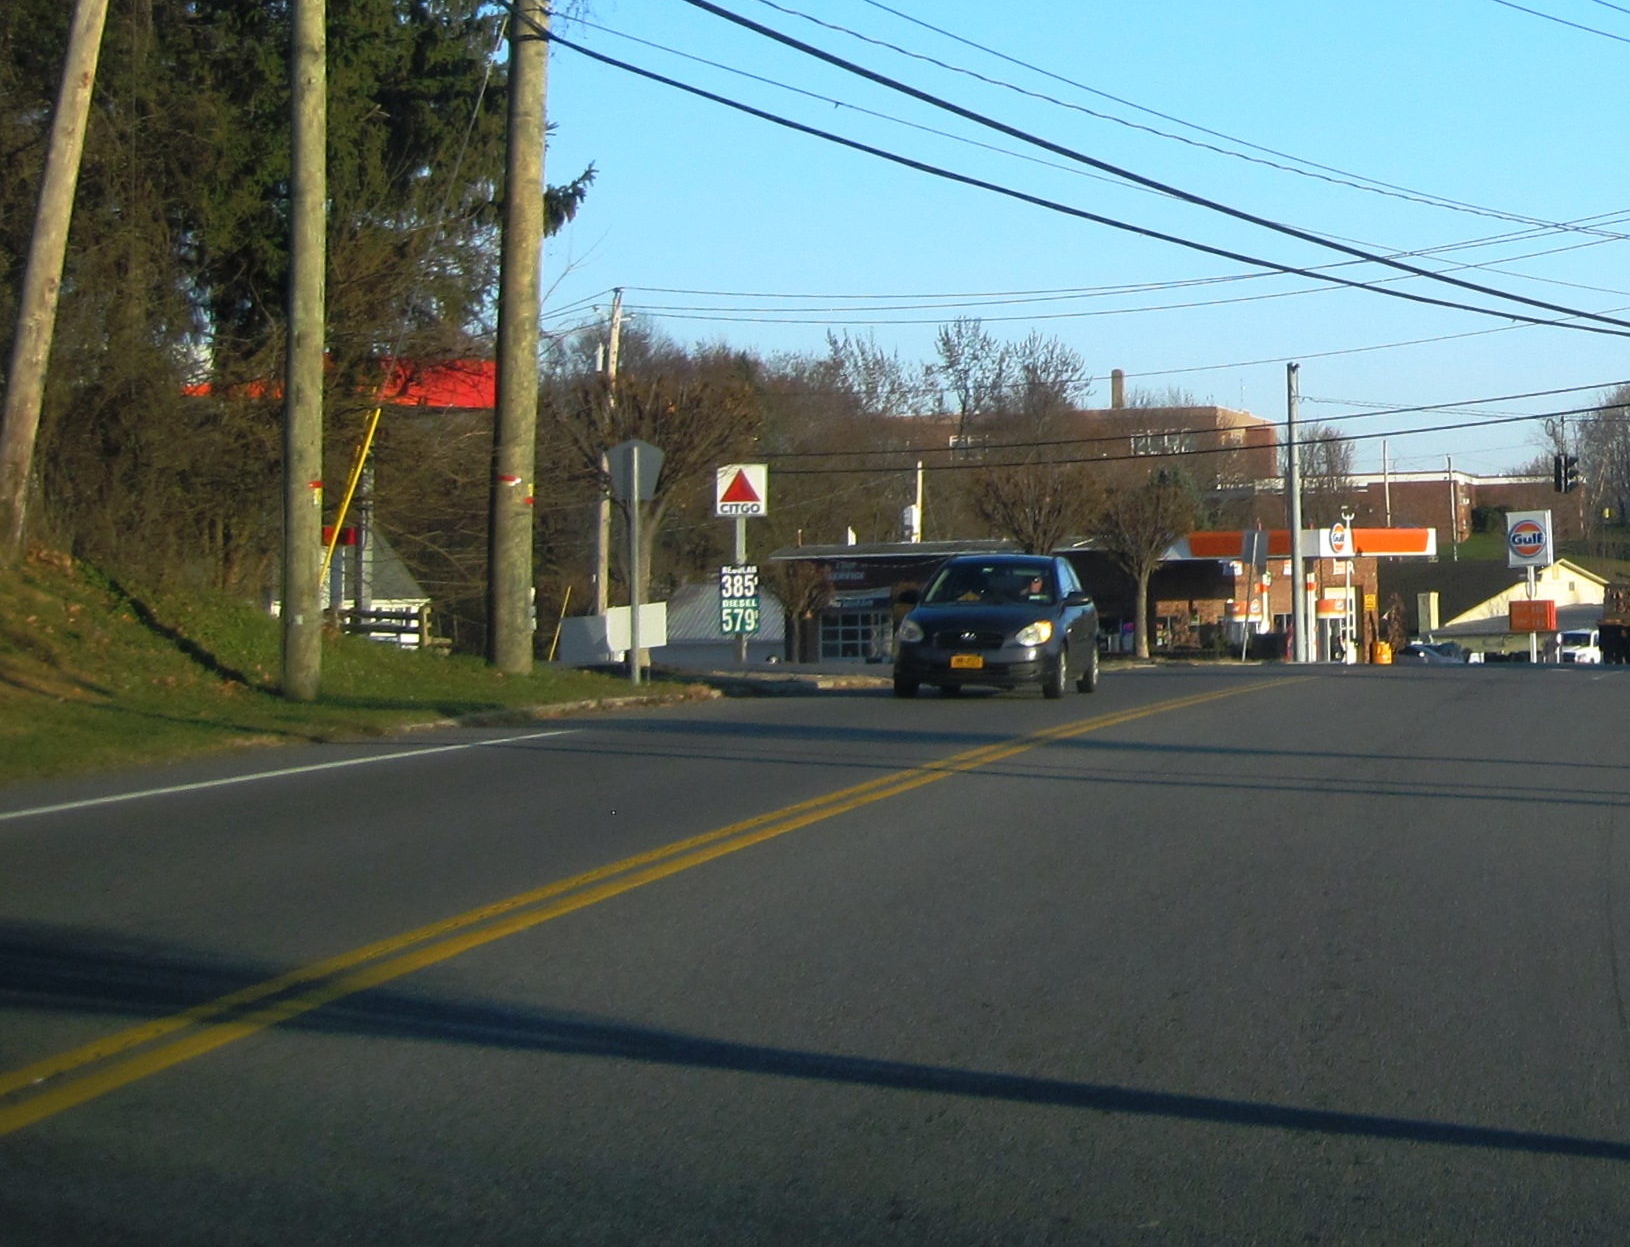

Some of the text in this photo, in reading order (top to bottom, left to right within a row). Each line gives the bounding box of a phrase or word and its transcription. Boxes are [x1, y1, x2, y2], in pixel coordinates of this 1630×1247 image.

[720, 503, 760, 514] CITGO
[1511, 533, 1543, 545] Gulf
[722, 599, 757, 607] DIESEL
